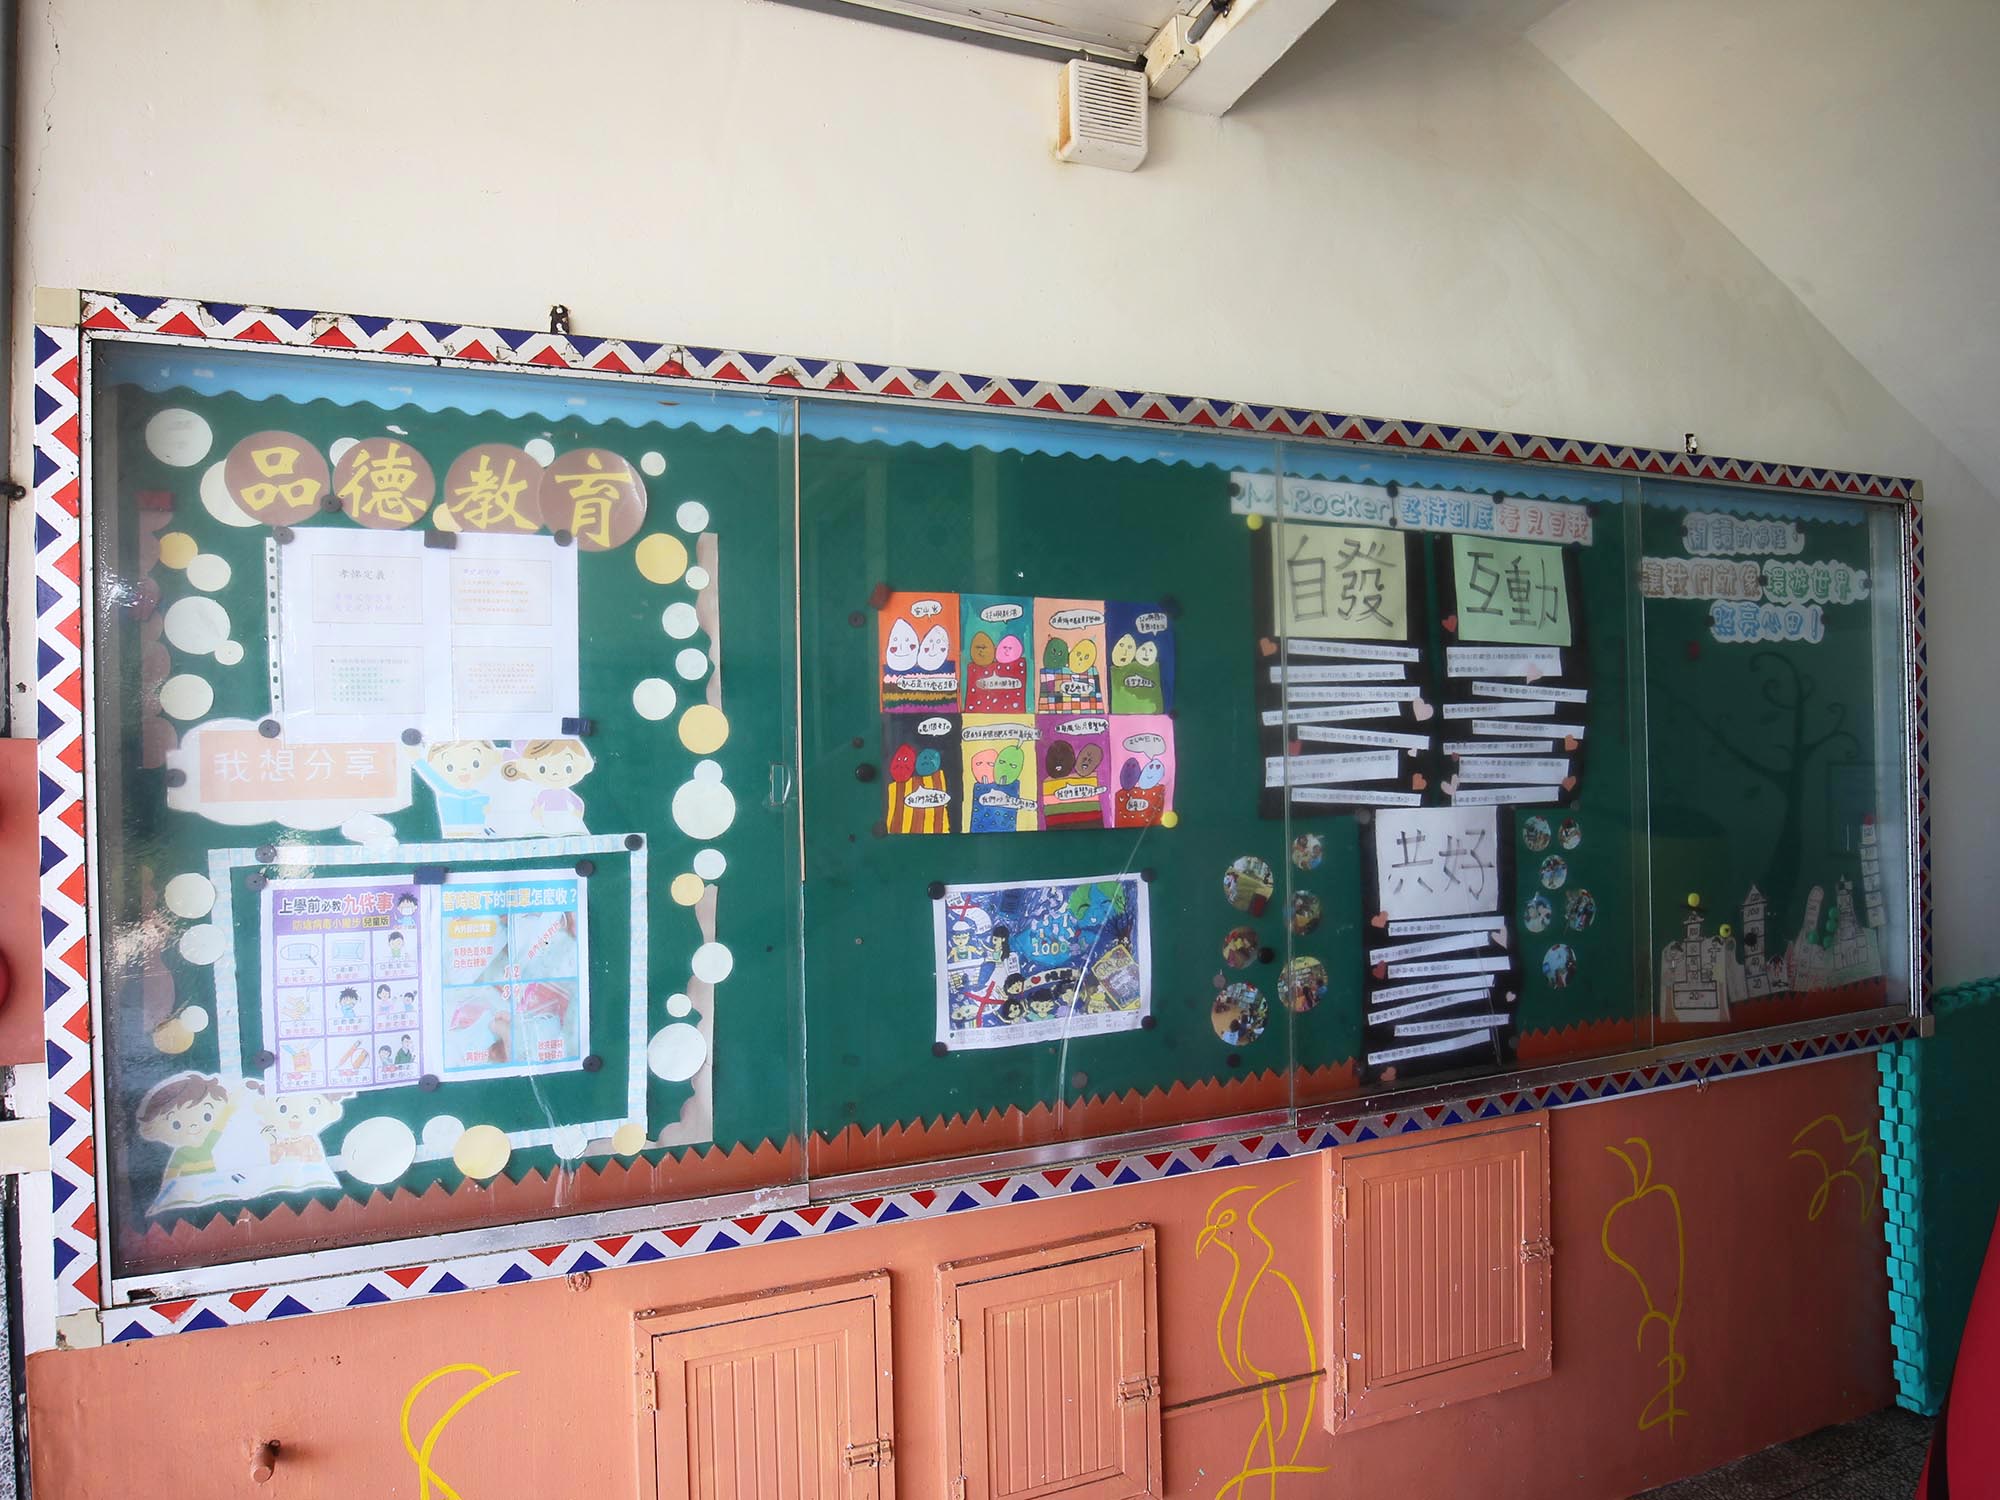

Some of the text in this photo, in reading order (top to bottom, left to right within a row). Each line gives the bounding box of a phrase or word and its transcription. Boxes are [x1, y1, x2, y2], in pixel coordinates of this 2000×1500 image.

[240, 443, 635, 548] 品德教育
[1401, 495, 1495, 531] 堅持到底
[1500, 502, 1590, 541] 看見自我
[1286, 533, 1397, 628] 自發
[1465, 551, 1559, 630] 互動
[214, 748, 381, 783] 我想分享
[1389, 828, 1495, 901] 共好
